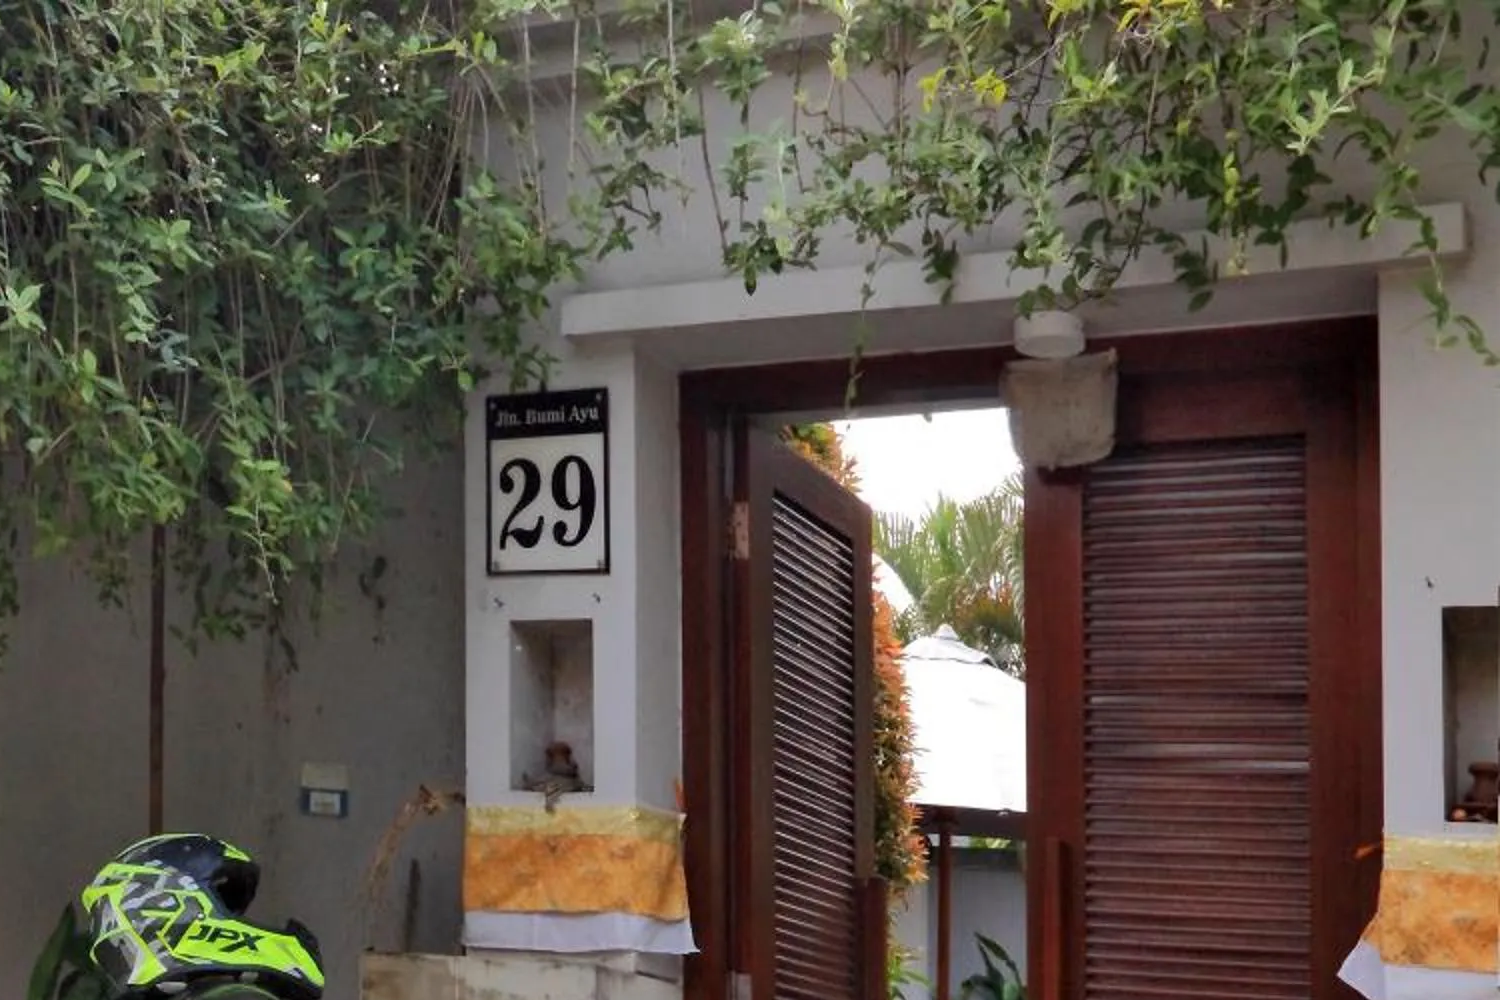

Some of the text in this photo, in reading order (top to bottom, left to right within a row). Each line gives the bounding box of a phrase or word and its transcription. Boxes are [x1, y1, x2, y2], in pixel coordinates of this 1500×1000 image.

[526, 406, 565, 424] Bumi
[569, 404, 599, 423] Ayu
[499, 455, 597, 551] 29
[187, 924, 265, 952] JPX
